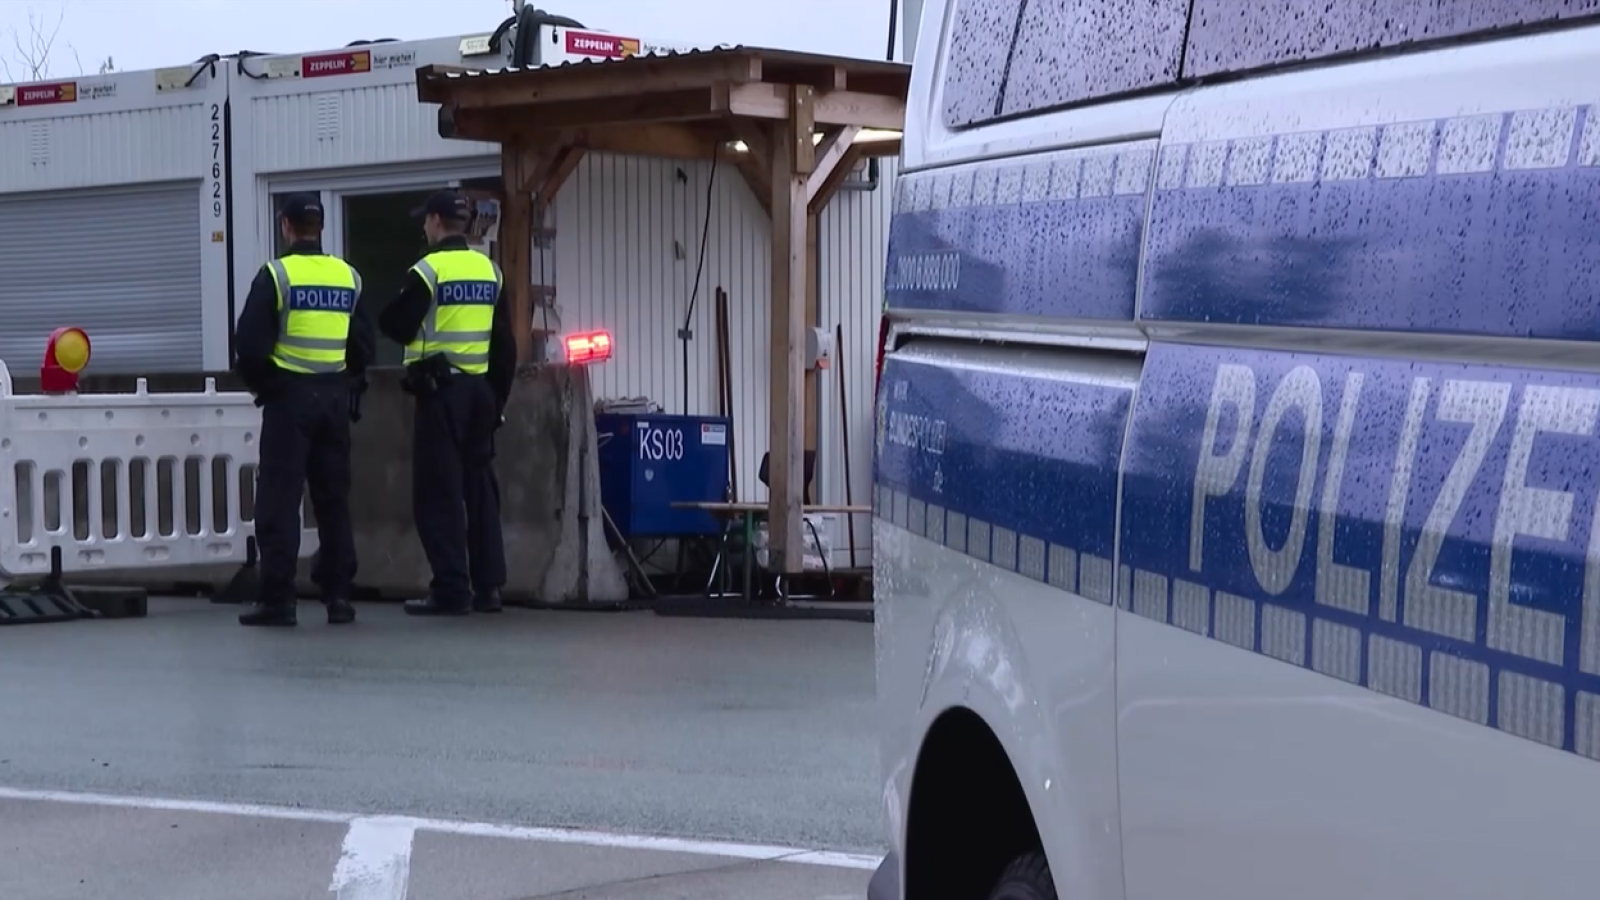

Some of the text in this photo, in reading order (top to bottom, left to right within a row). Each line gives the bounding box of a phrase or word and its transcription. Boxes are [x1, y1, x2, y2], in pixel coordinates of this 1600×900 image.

[574, 37, 614, 52] ZEPPELIN
[310, 59, 346, 72] ZEPPELIN
[23, 89, 56, 101] ZEPPELIN
[211, 103, 222, 218] 227629
